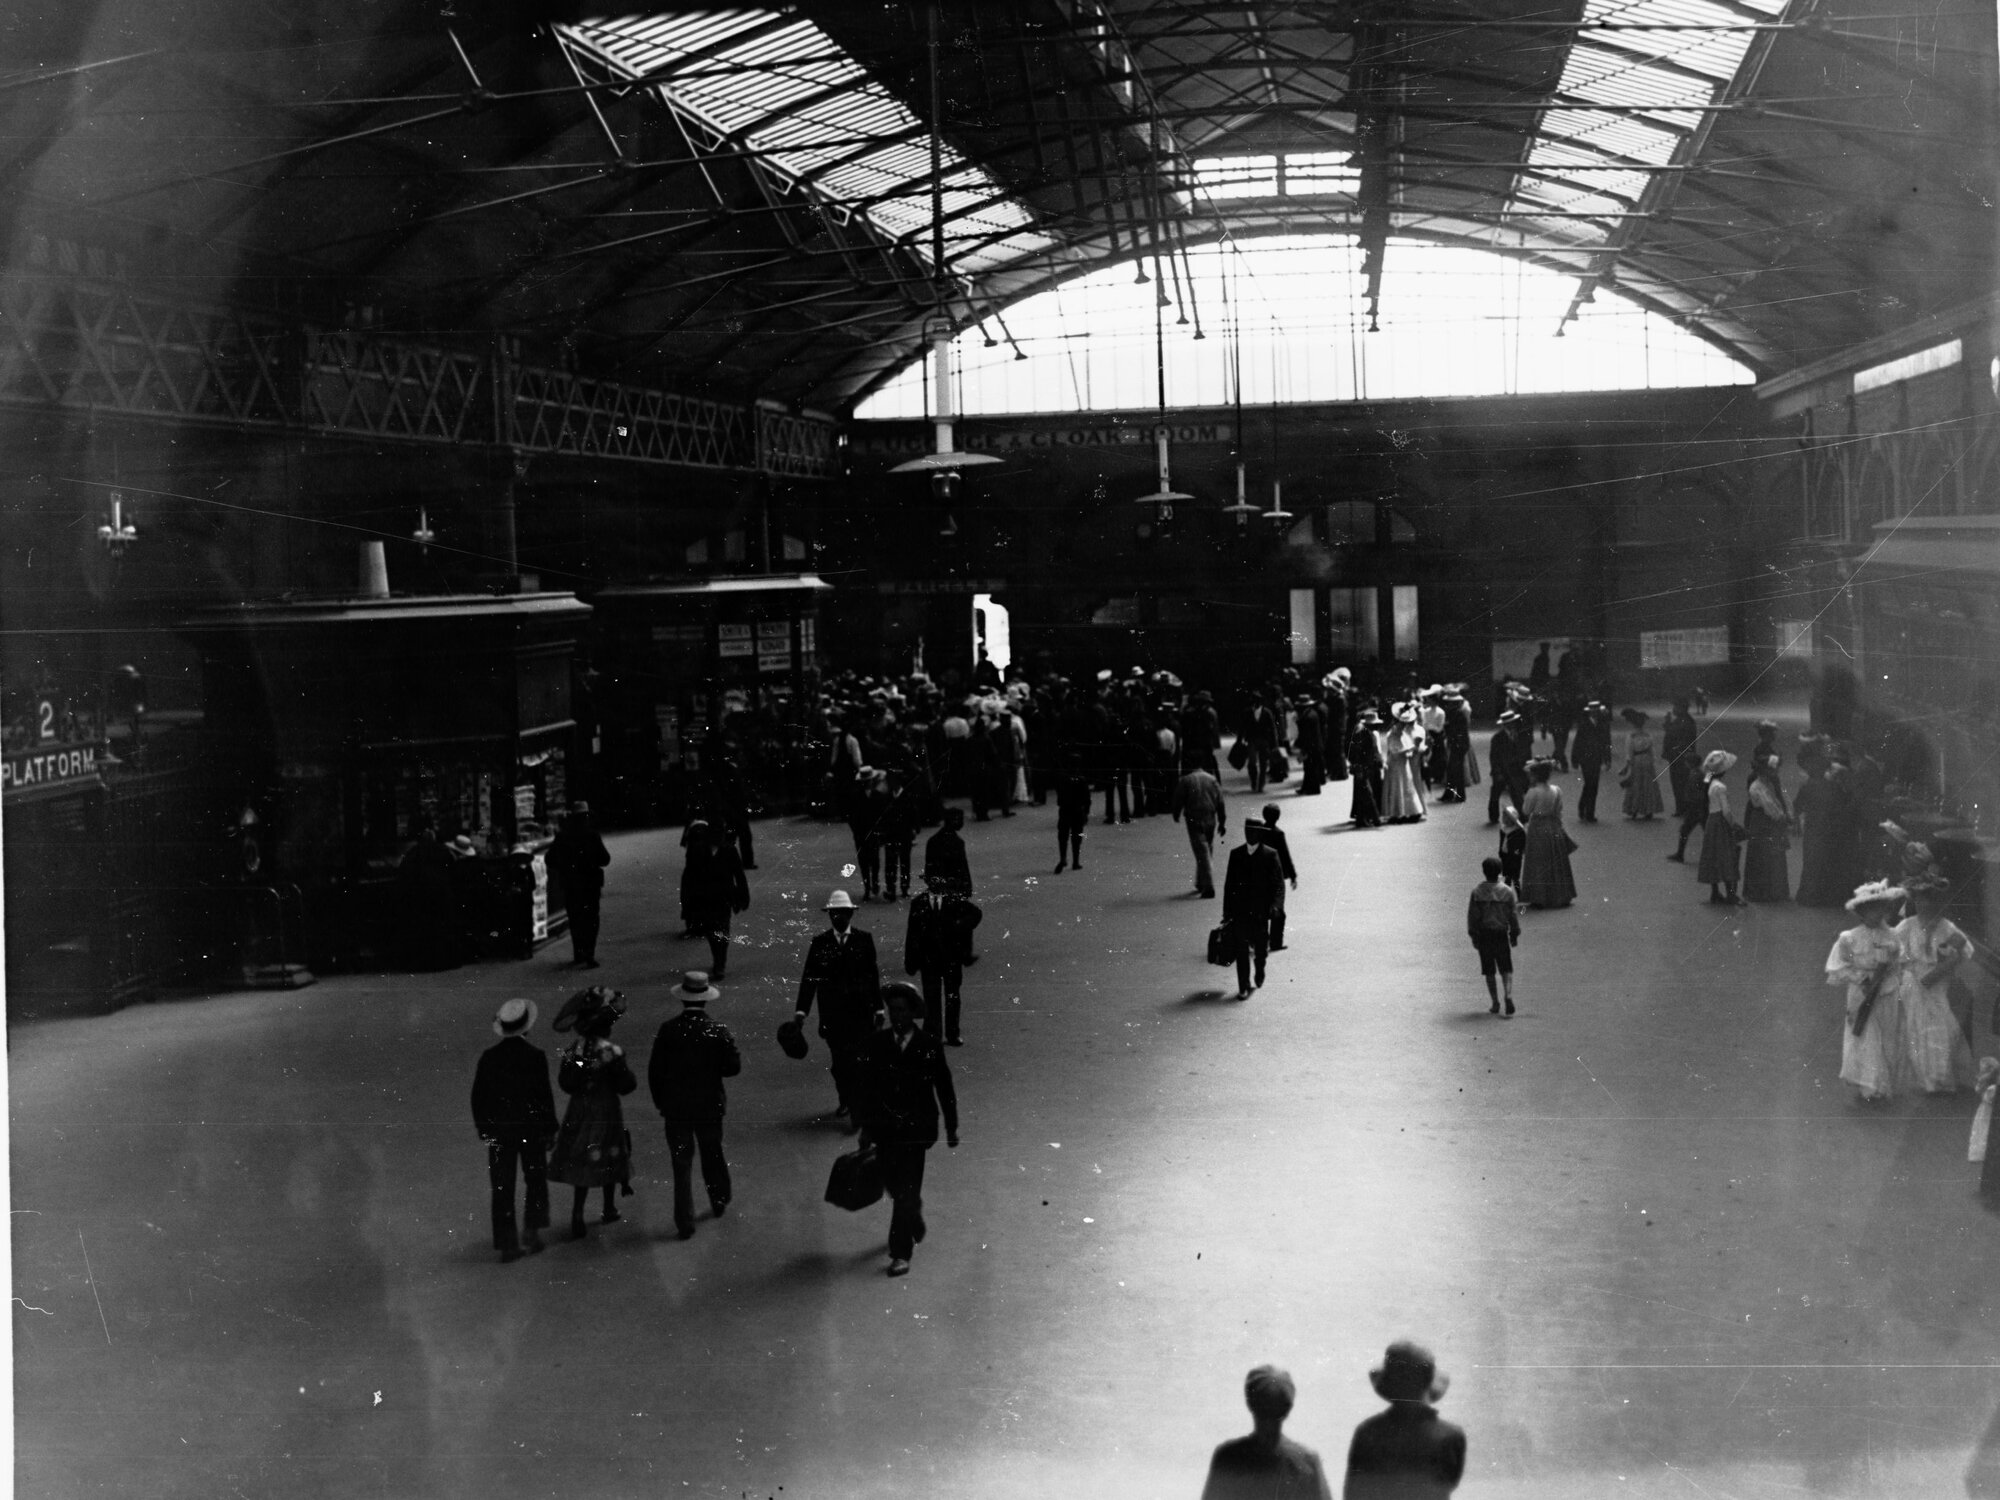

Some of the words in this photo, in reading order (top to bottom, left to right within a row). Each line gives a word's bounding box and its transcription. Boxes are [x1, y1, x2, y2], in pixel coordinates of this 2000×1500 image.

[1030, 429, 1121, 448] CLOAK
[1139, 425, 1218, 443] ROM
[40, 701, 55, 738] 2
[2, 748, 95, 787] PLATFORM
